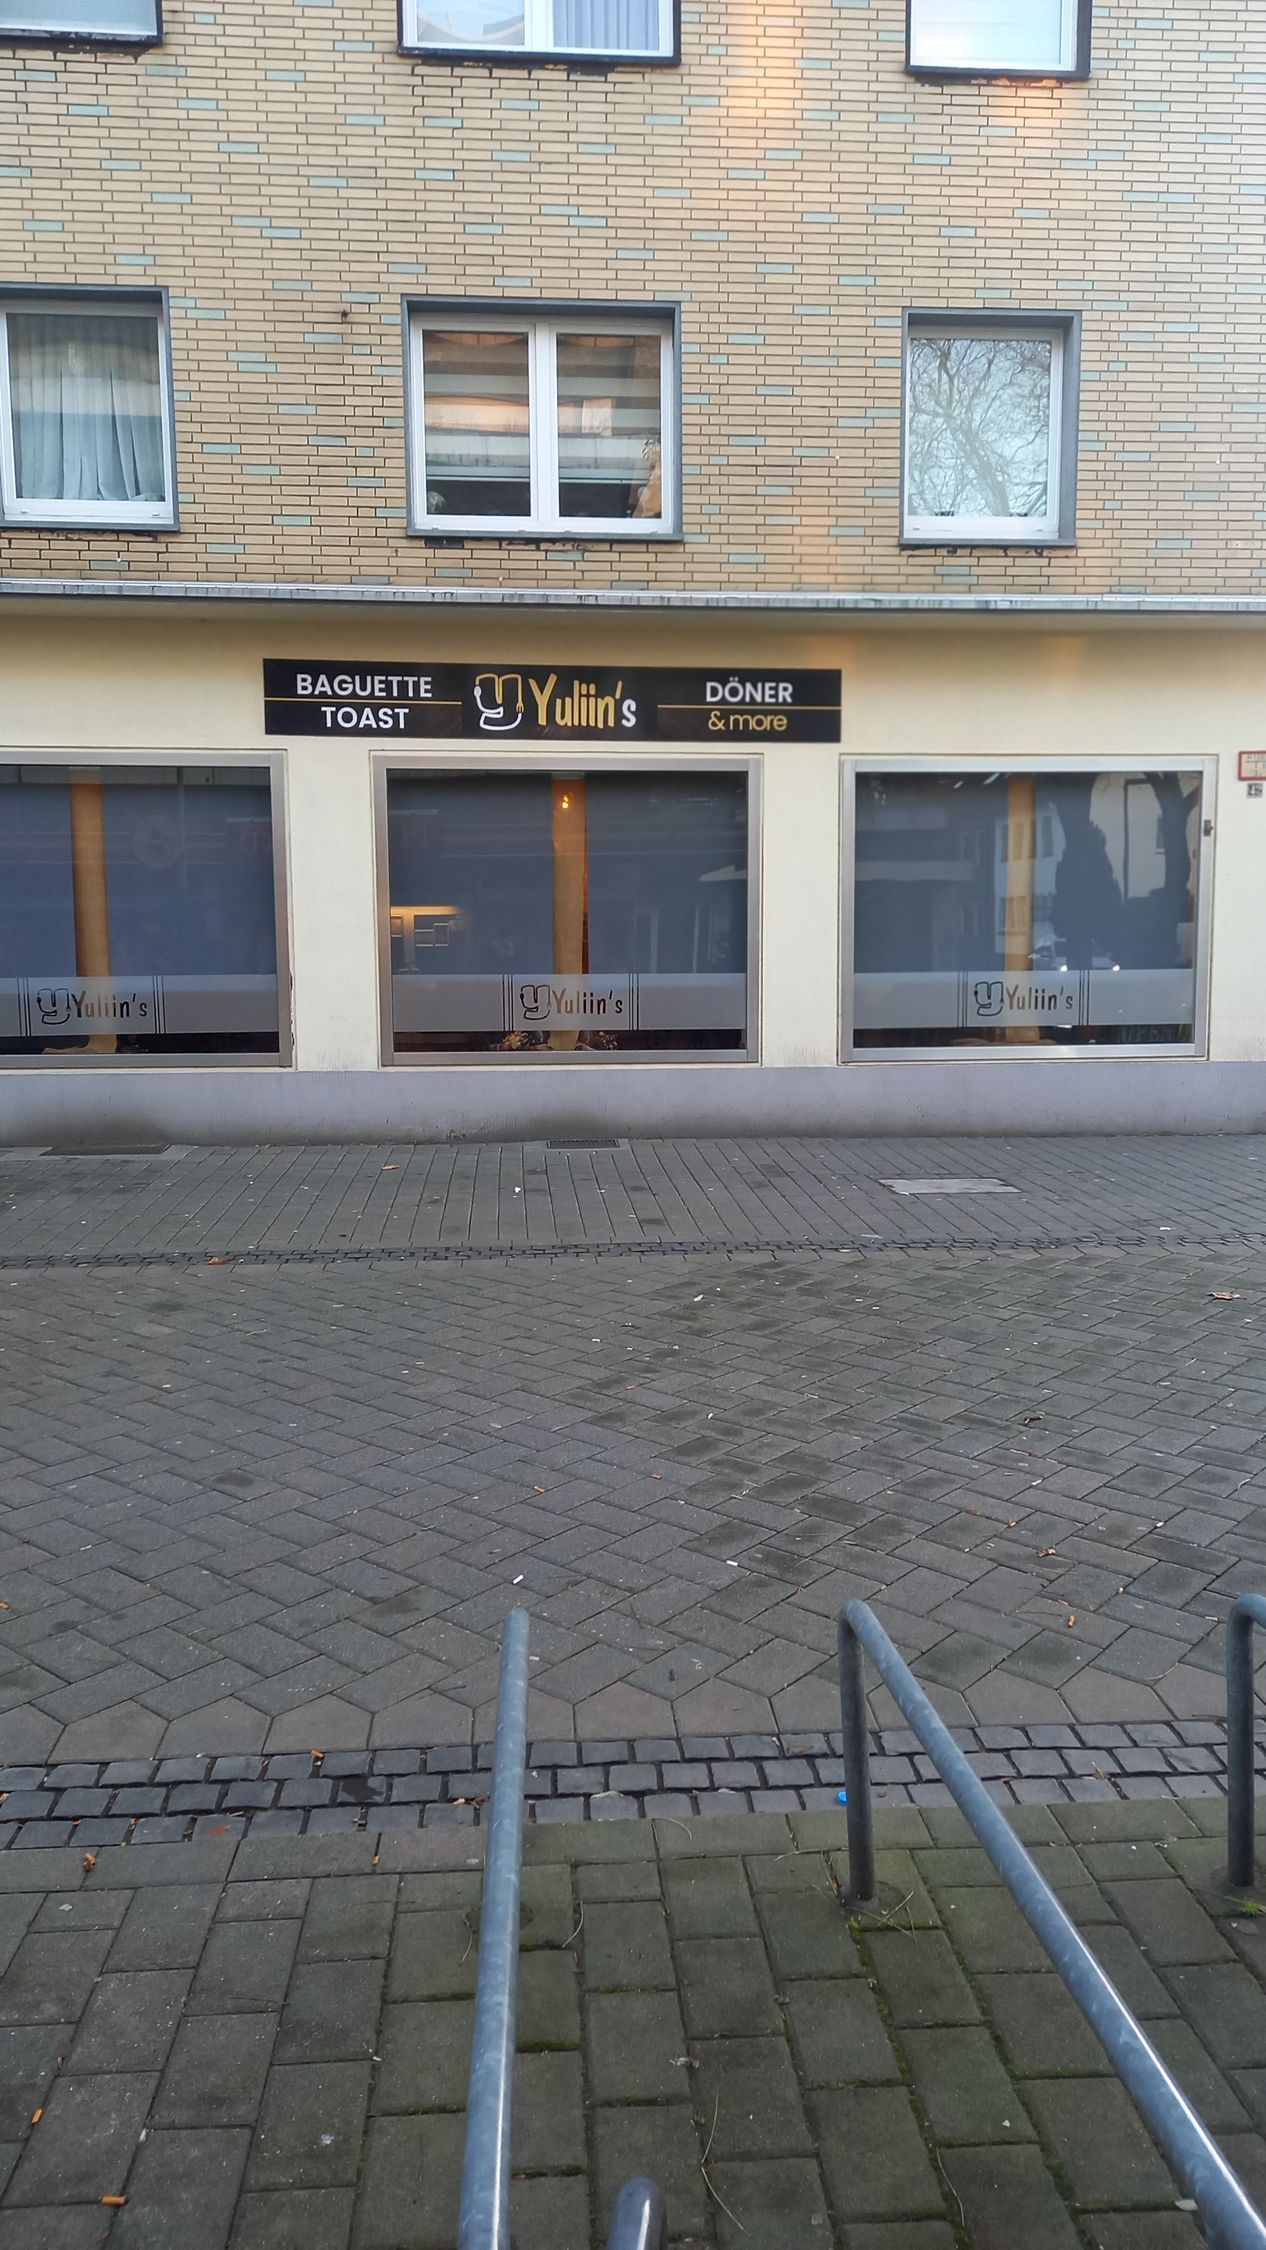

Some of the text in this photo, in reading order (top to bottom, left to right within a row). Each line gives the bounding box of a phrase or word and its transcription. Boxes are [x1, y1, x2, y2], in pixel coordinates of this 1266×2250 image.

[296, 673, 433, 698] BAGUETTE
[705, 676, 794, 703] DÖNER
[528, 673, 638, 729] Yuliin's
[320, 706, 410, 729] TOAST
[707, 710, 788, 731] & more
[71, 990, 148, 1018] Yuliin's
[552, 988, 623, 1015] Yuliin's
[1005, 984, 1074, 1011] Yuliin's
